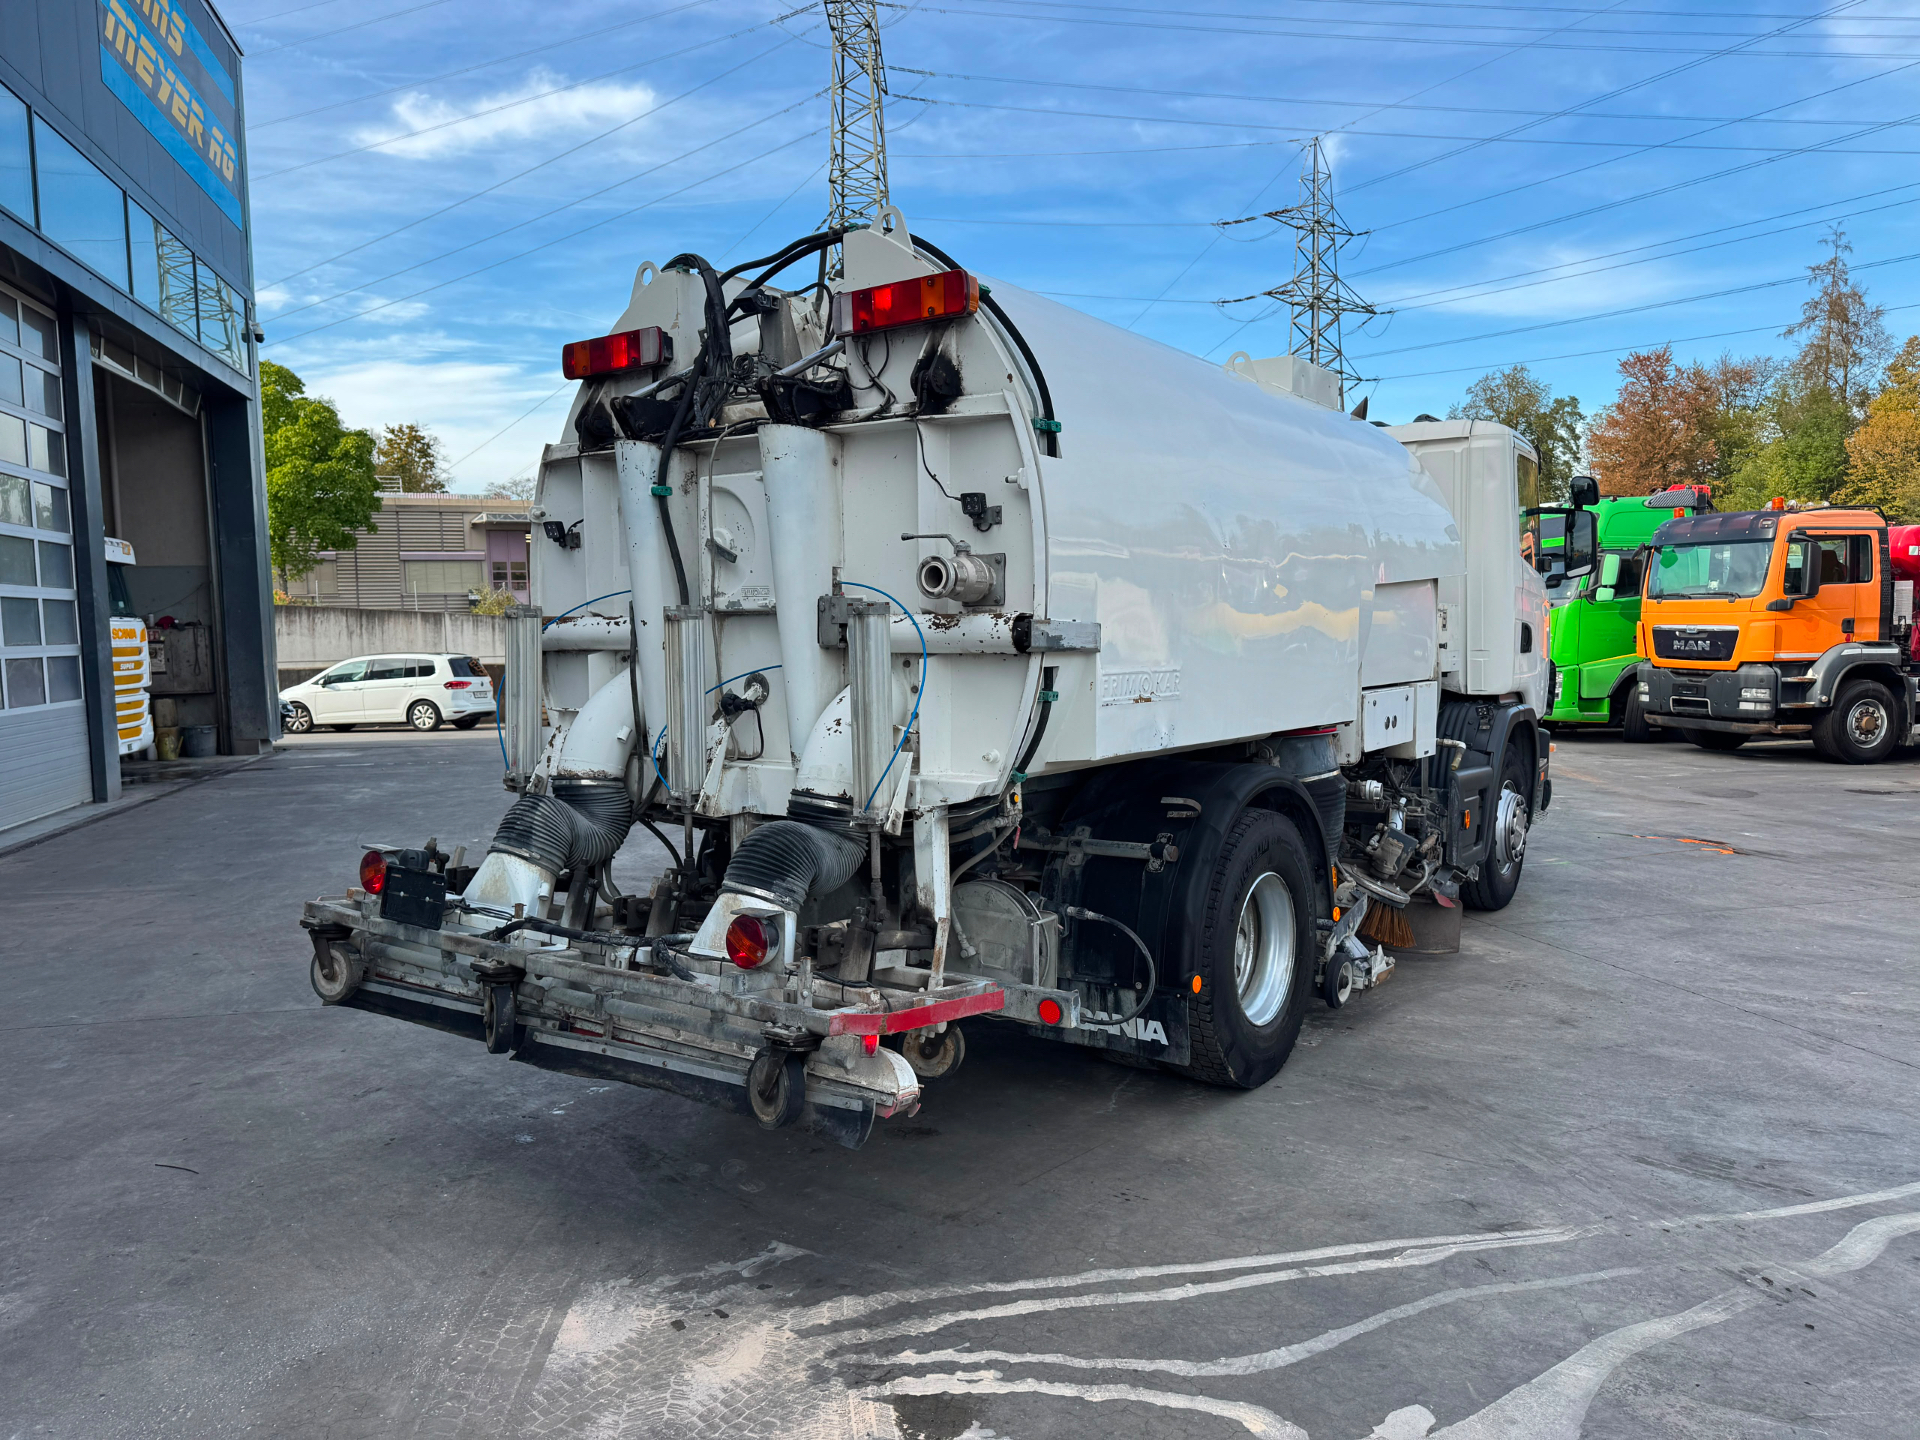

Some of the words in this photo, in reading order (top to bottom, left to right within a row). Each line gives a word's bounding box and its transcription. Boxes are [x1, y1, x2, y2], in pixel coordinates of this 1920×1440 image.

[104, 0, 204, 148] MEYER
[208, 126, 235, 182] AG
[112, 628, 137, 639] SCANIA
[1673, 640, 1711, 651] MAN
